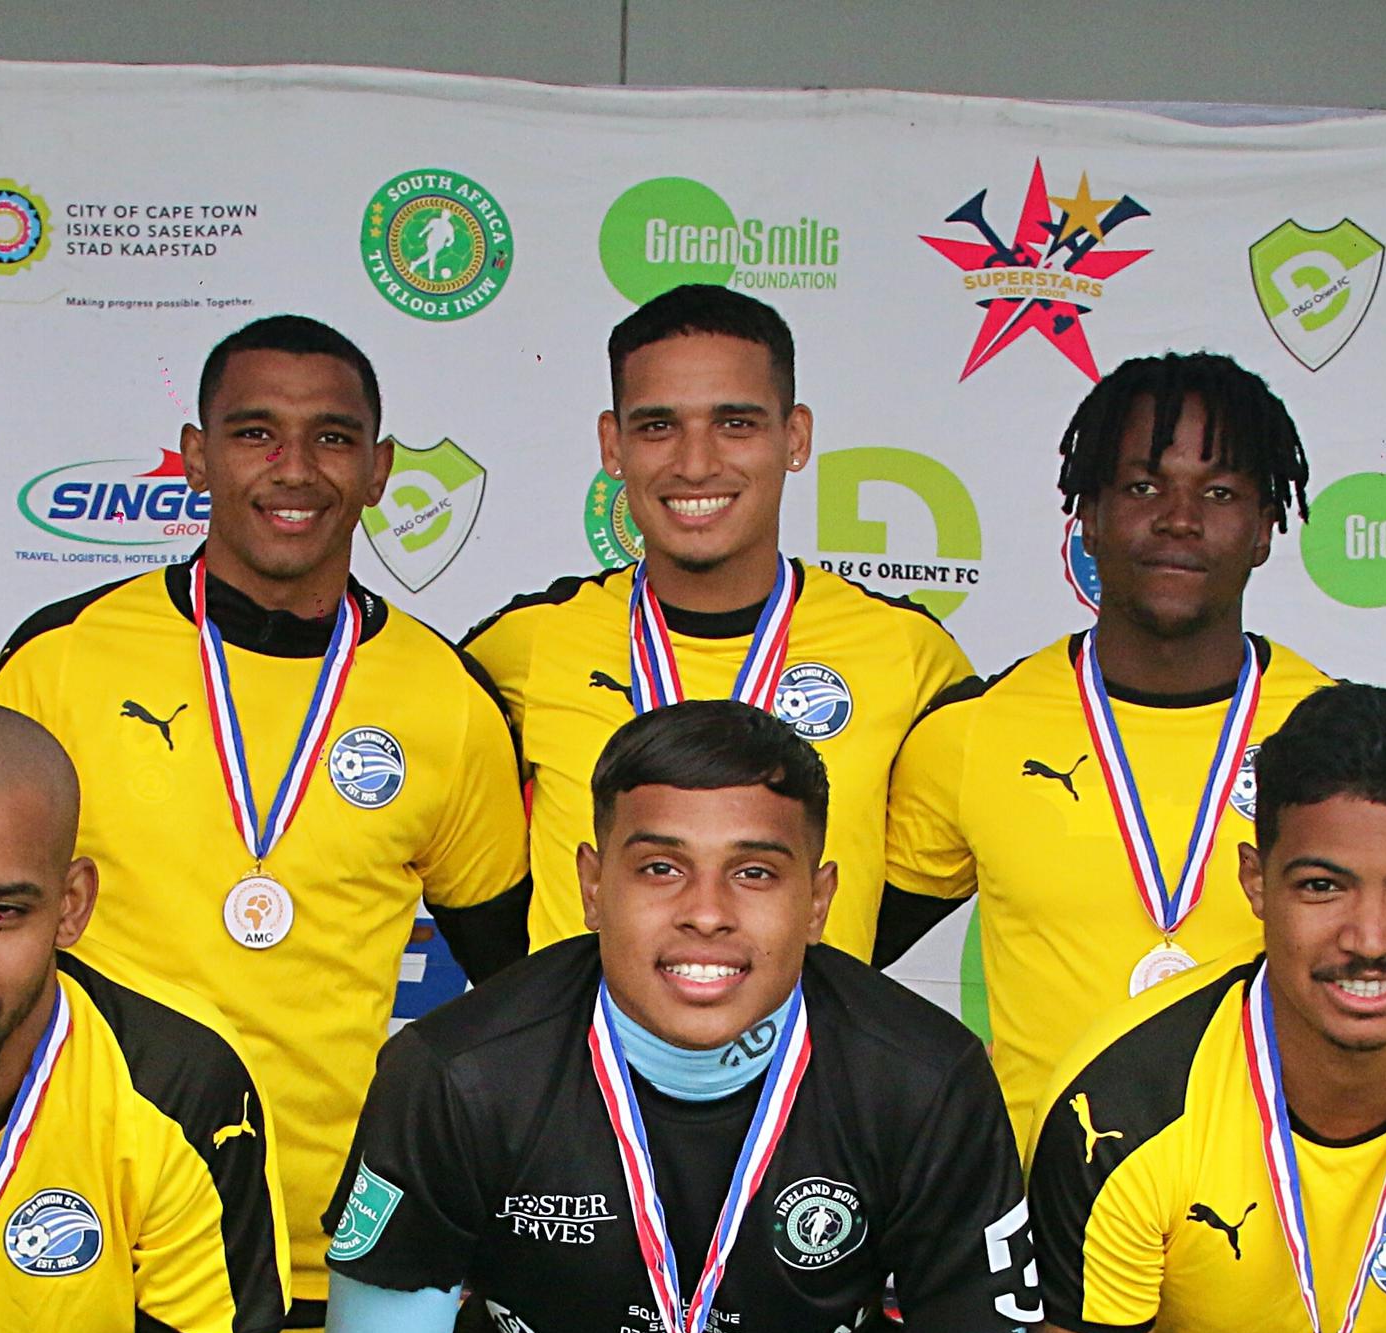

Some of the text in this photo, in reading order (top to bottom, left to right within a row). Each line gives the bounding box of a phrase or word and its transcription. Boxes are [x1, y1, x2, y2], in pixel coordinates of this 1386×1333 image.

[66, 204, 257, 219] CITY OF CAPE TOWN
[387, 174, 507, 245] SOUTH AFRICA
[66, 223, 243, 238] ISIXEKO SASEKAPA
[66, 242, 217, 257] STAD KAAPSTAD
[368, 249, 497, 316] MINI FOOTBALL
[734, 271, 837, 289] FOUNDATION
[963, 271, 1103, 297] SUPERSTARS
[1337, 276, 1350, 288] FC
[997, 287, 1032, 296] SINCE
[66, 297, 255, 309] Making progress possible. Together.
[48, 483, 211, 520] SINGE
[393, 498, 452, 537] D&G Orient FC
[164, 523, 209, 536] GROU
[15, 551, 58, 562] TRAVEL,
[62, 552, 121, 563] LOGISTICS,
[124, 553, 167, 564] HOTELS
[171, 554, 179, 564] &
[820, 561, 979, 584] D & G ORIENT FC
[244, 932, 274, 944] AMC
[349, 1191, 378, 1221] UTUAL
[503, 1194, 609, 1217] FOSTER
[776, 1184, 860, 1217] IRELAND BOYS
[36, 1258, 56, 1269] EST.
[798, 1248, 840, 1264] FIVES
